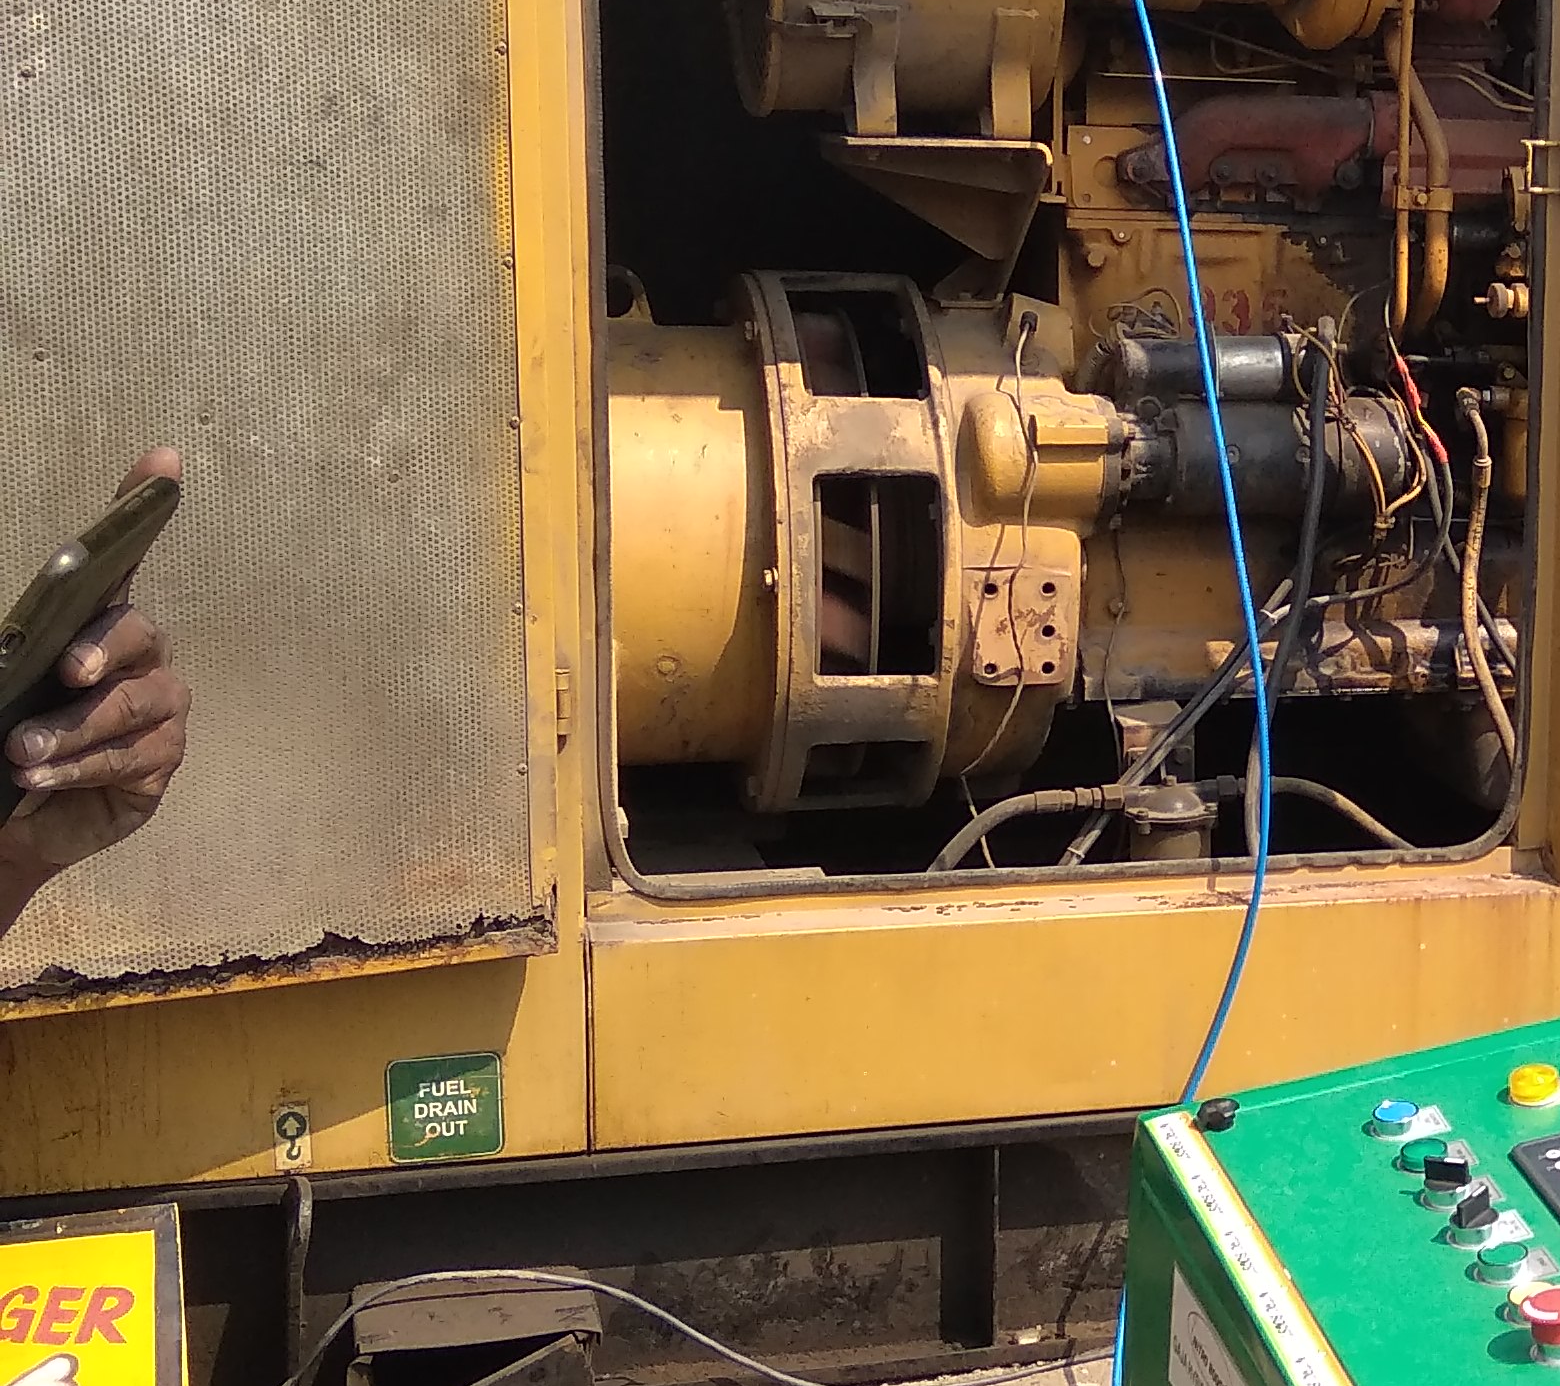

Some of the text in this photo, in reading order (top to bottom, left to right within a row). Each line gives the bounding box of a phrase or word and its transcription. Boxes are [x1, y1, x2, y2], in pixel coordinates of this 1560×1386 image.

[419, 1080, 472, 1098] FUEL
[414, 1098, 477, 1119] DRAIN
[425, 1120, 468, 1138] OUT
